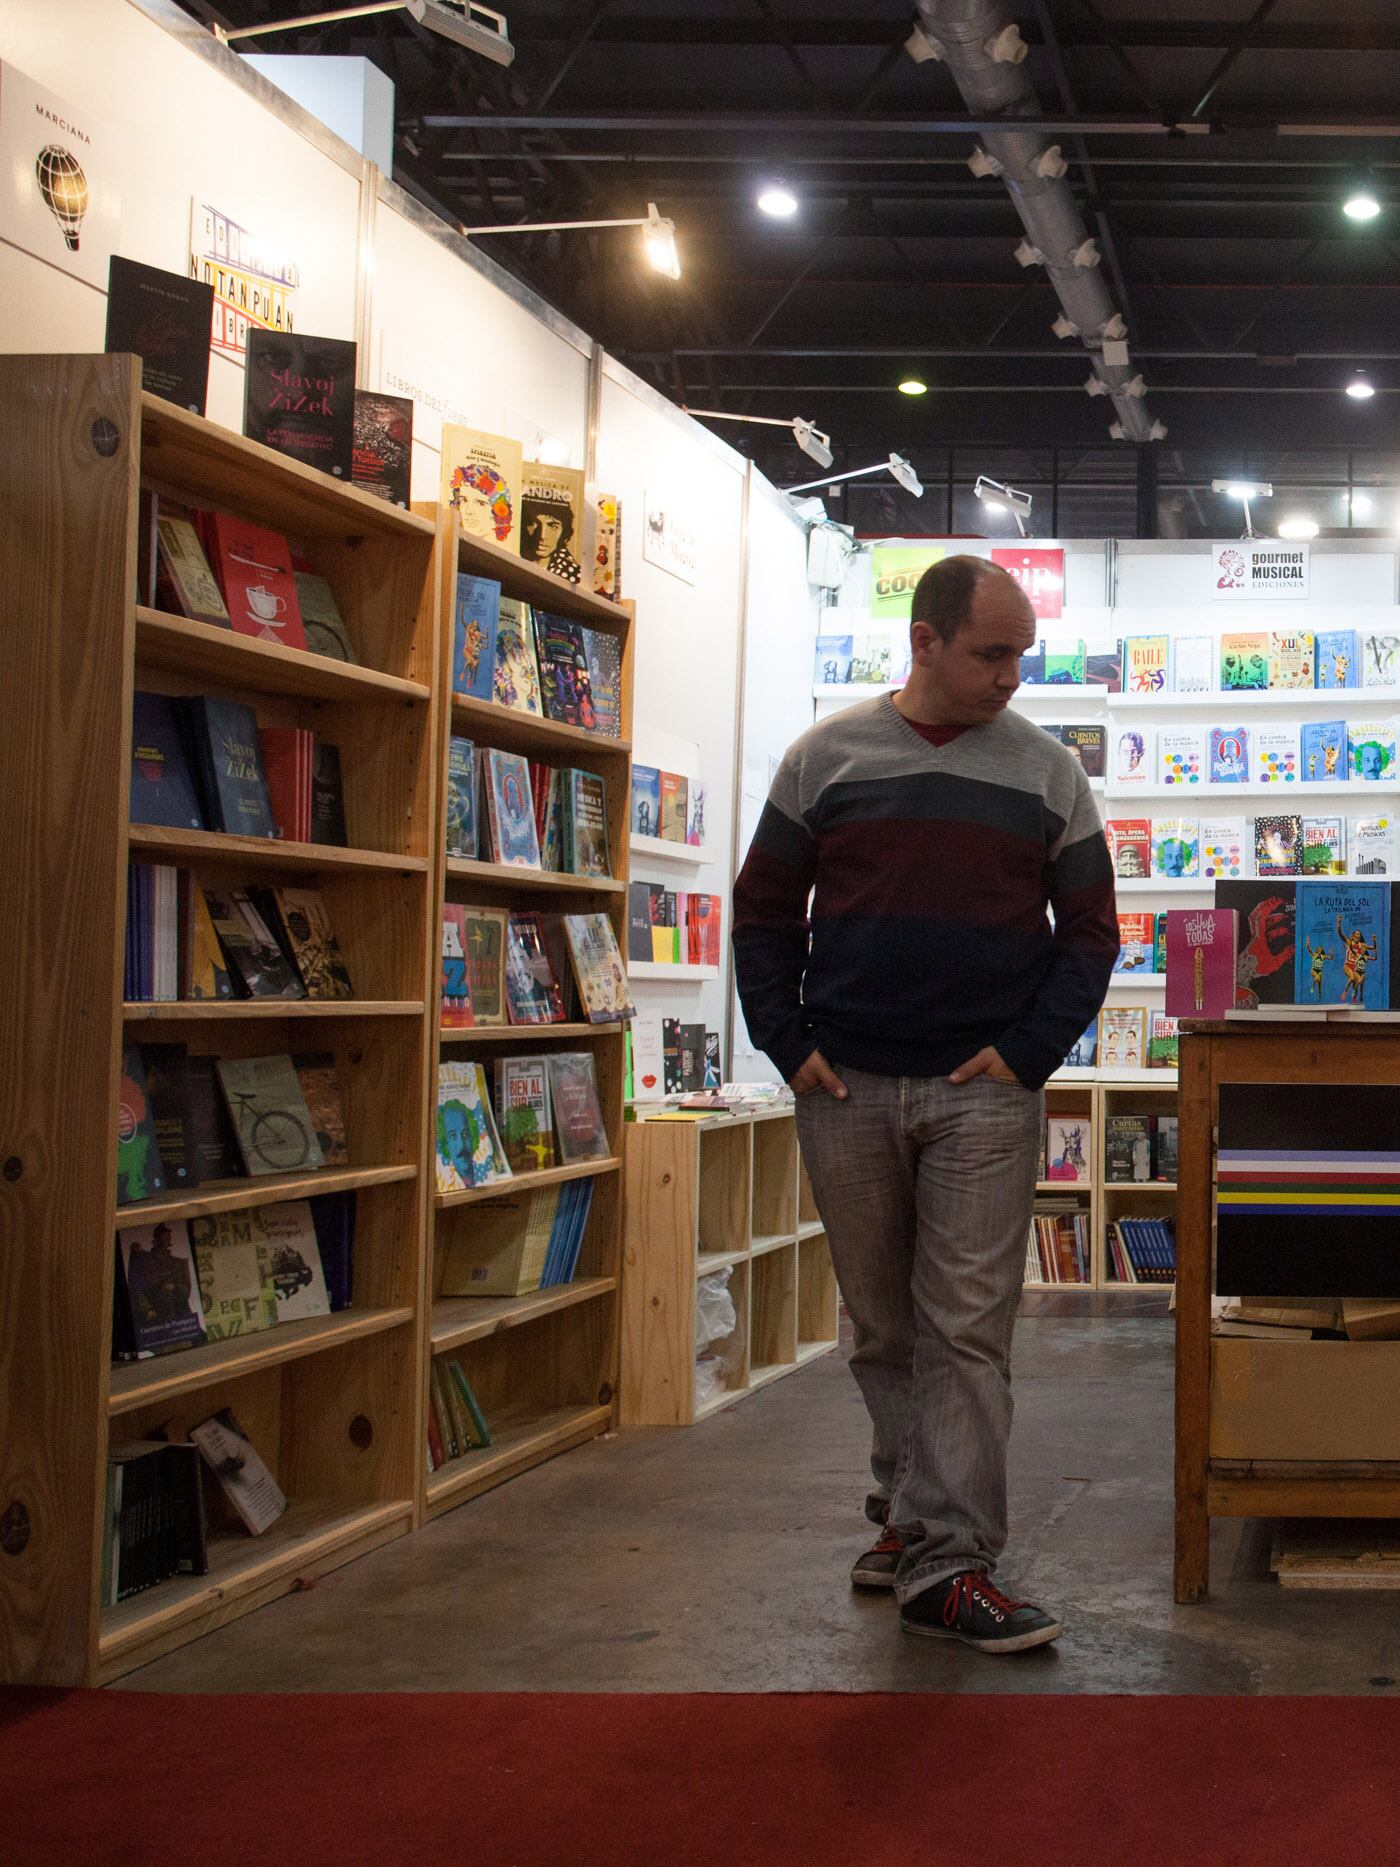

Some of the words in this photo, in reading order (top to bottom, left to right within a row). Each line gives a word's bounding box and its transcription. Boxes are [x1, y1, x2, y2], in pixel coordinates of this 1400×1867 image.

[36, 104, 91, 146] MARCIANA
[270, 368, 334, 397] Slavoj
[386, 371, 422, 402] LIBROS
[522, 485, 573, 502] ANDRO
[1252, 552, 1304, 566] gourmet
[1252, 566, 1304, 579] MUSICAL
[1252, 581, 1305, 589] EDICIONES
[1133, 648, 1164, 666] BAILE
[1305, 829, 1324, 839] BIEN
[1327, 828, 1337, 838] AL
[1358, 897, 1372, 907] SOL
[1186, 930, 1213, 944] TODAS
[1155, 1021, 1174, 1031] BIEN
[1155, 1031, 1172, 1041] SUR
[510, 1078, 529, 1097] BIEN
[531, 1078, 542, 1096] AL
[1112, 1119, 1142, 1127] Cartas
